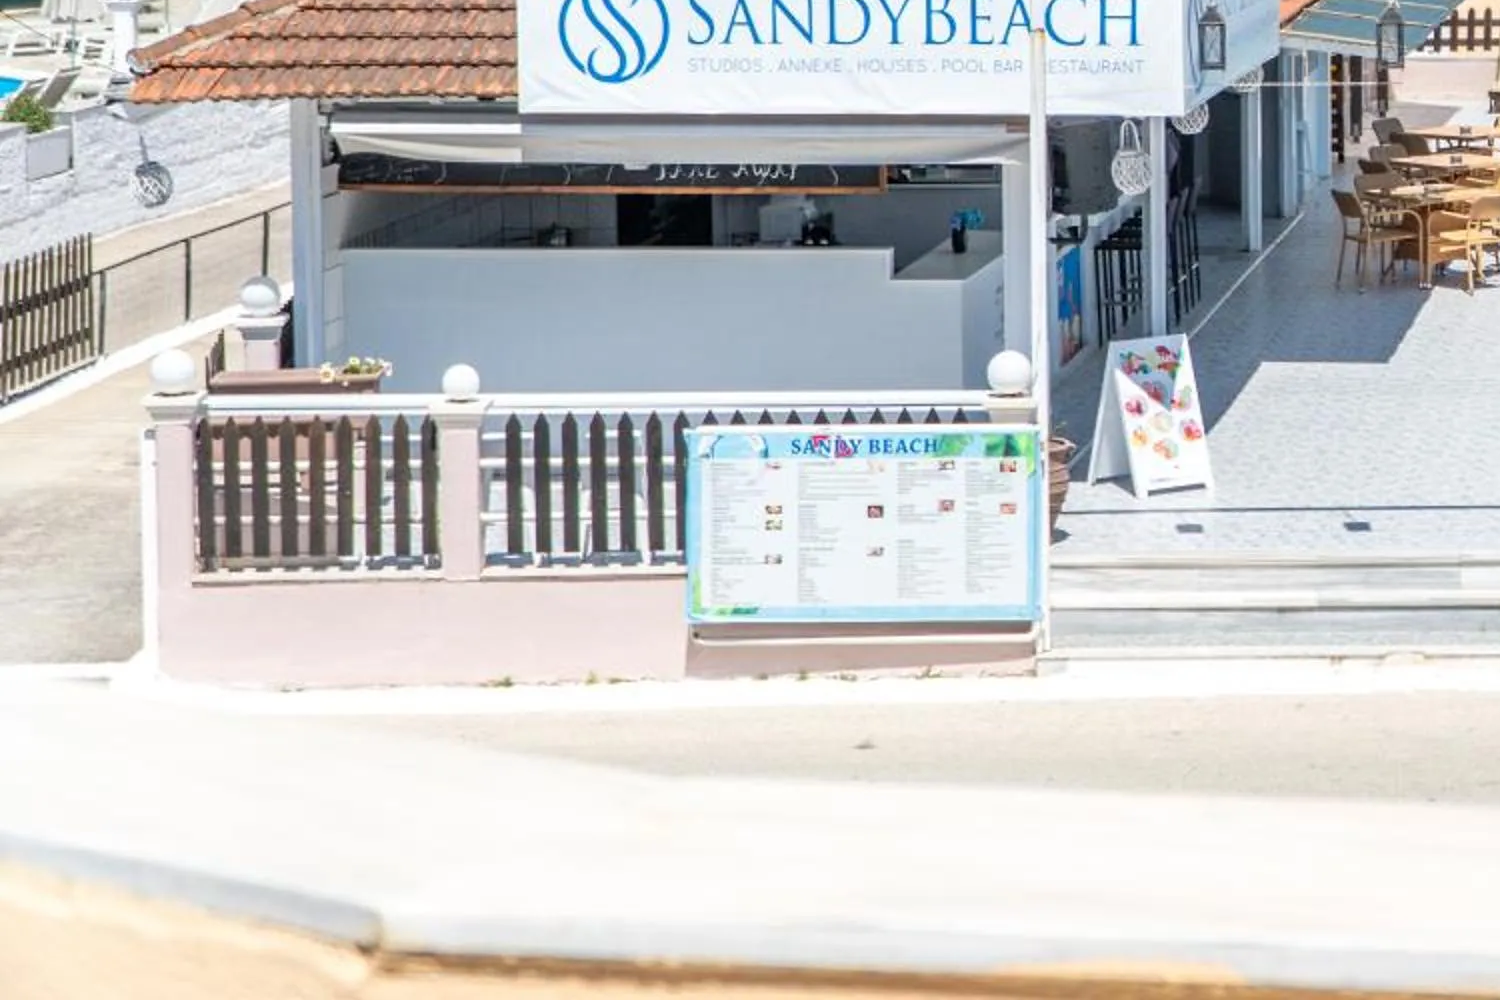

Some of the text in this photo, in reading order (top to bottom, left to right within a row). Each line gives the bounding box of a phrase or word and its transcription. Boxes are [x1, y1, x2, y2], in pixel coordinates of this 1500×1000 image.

[687, 57, 763, 73] STUDIOS
[856, 58, 928, 73] HOUSES
[941, 58, 988, 73] POOL
[993, 59, 1024, 73] BAR
[1043, 59, 1145, 74] ESTAURANT
[791, 438, 938, 455] SANDY BEACH
